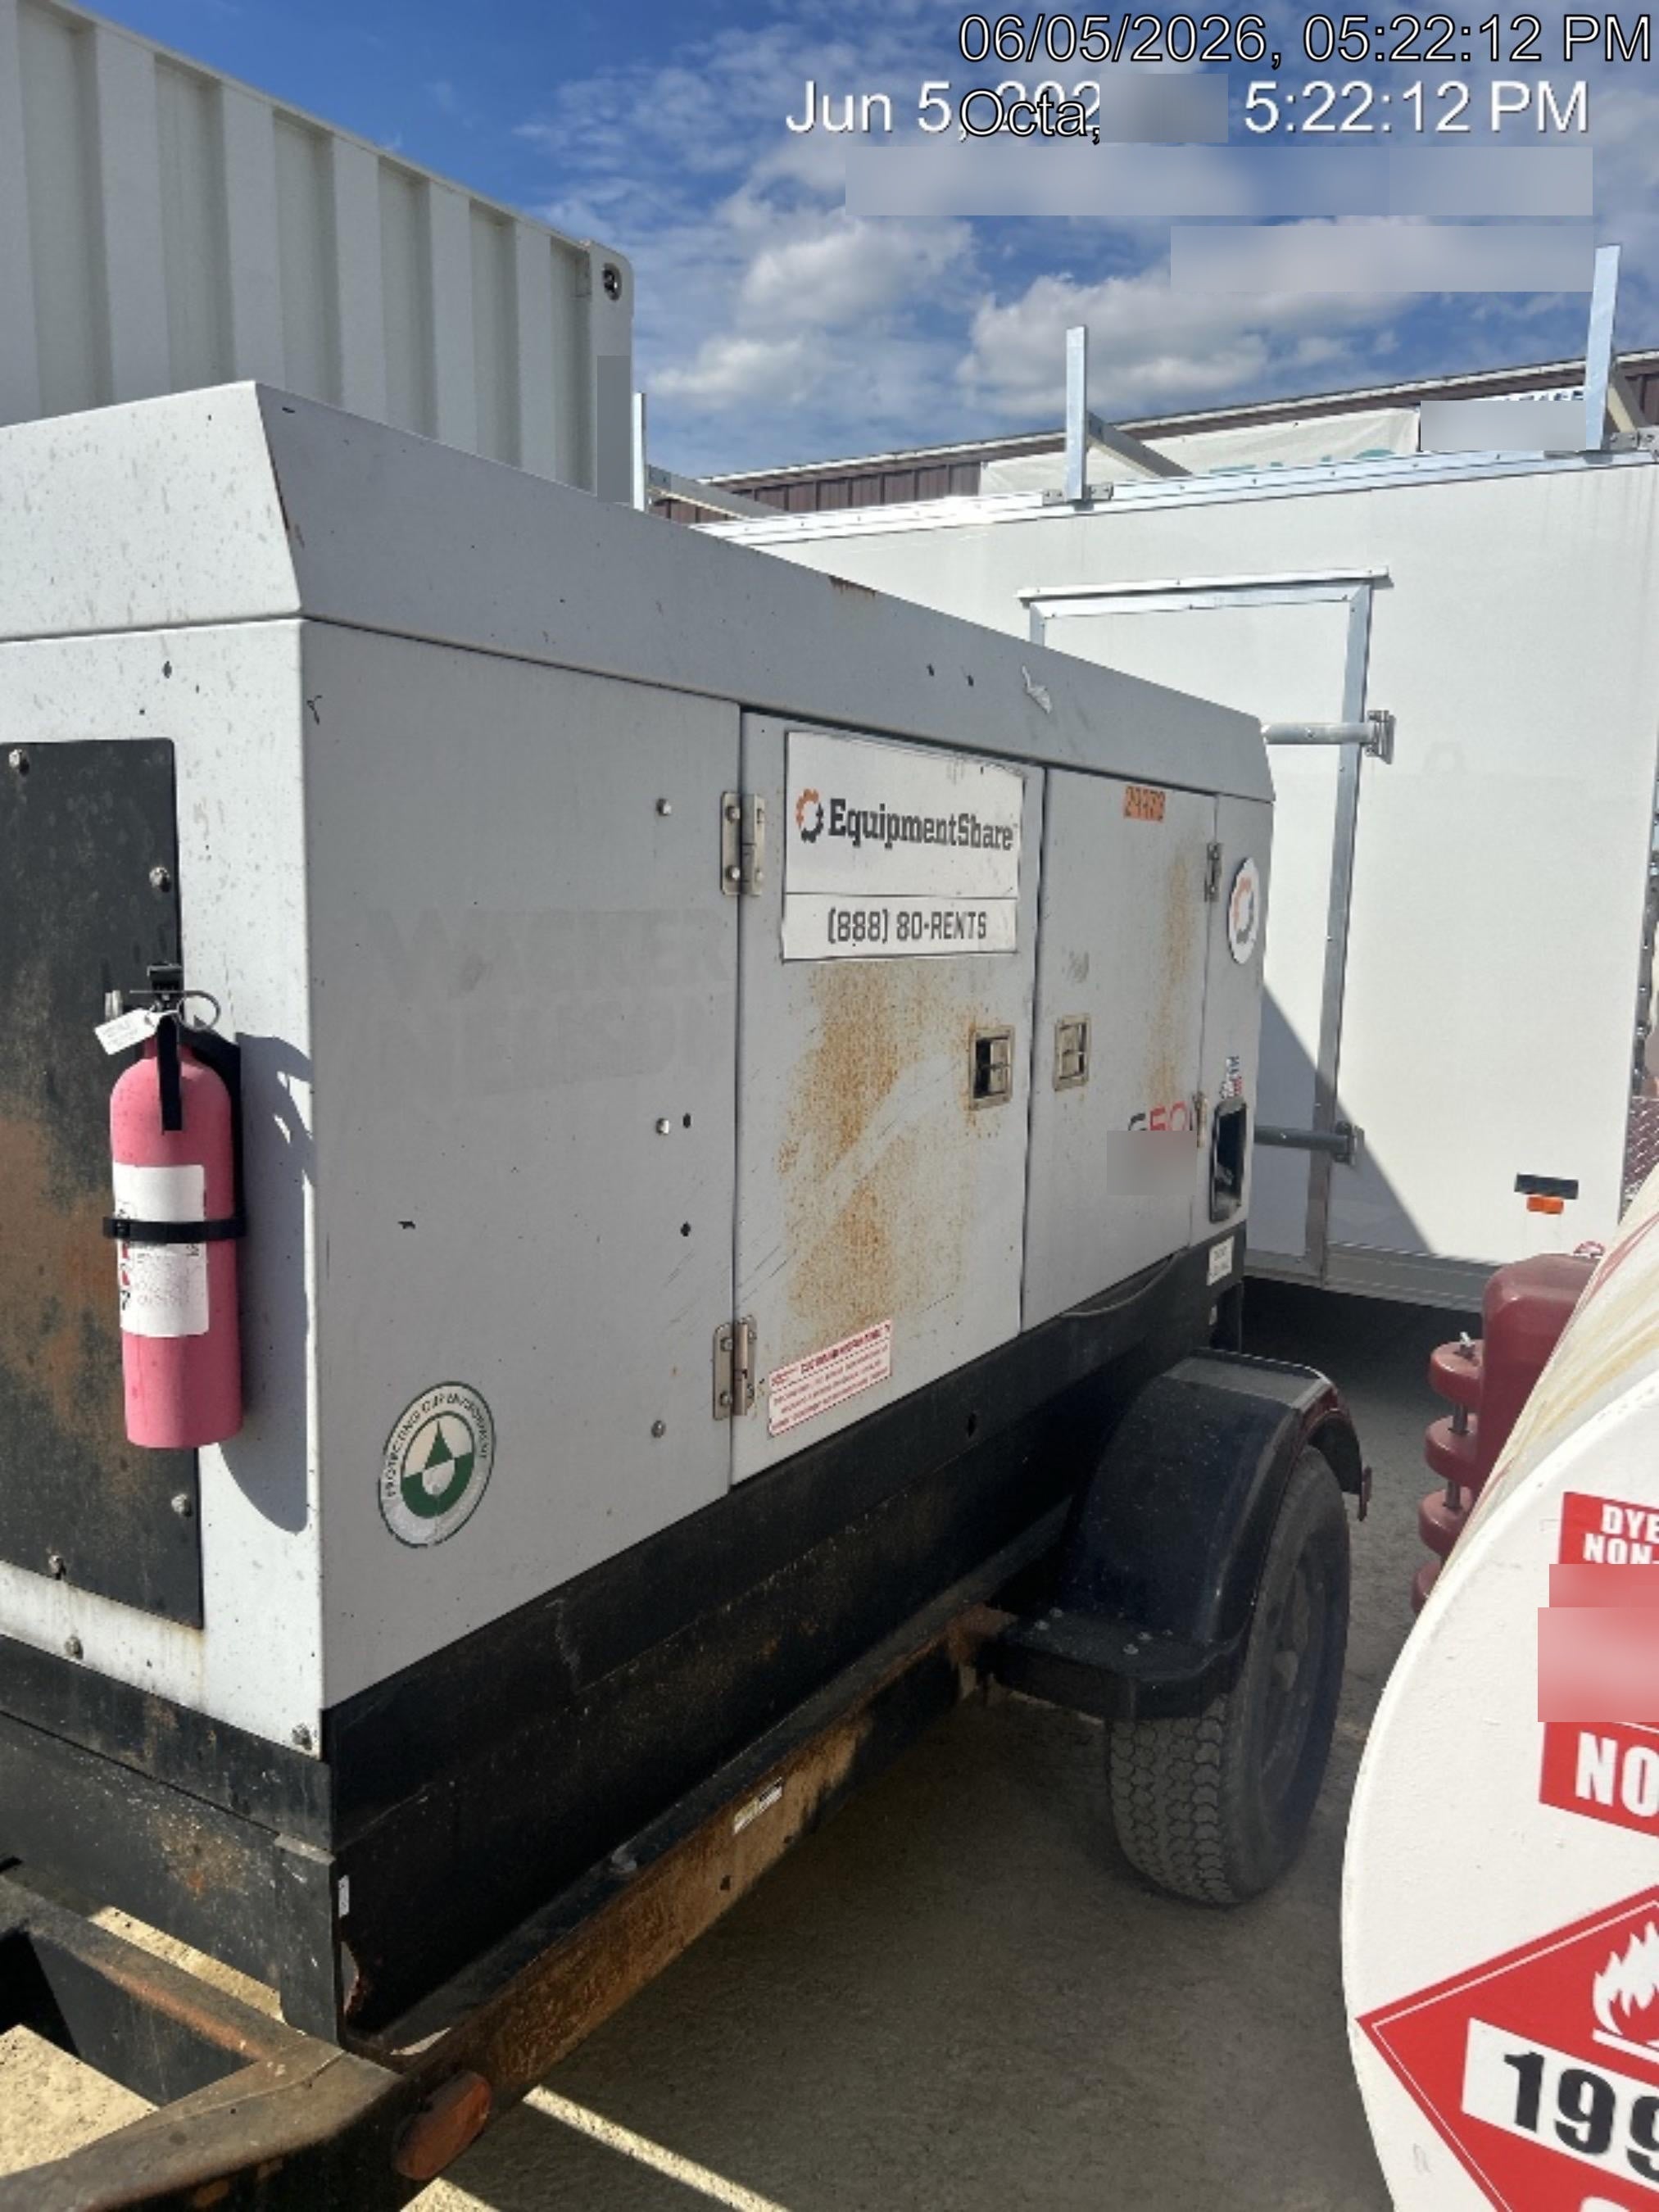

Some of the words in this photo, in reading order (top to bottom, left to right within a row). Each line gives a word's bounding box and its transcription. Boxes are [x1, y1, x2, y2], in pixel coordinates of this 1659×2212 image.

[827, 797, 1013, 850] EquipmentShare
[827, 907, 889, 944] (888)
[1575, 1730, 1659, 1818] NO
